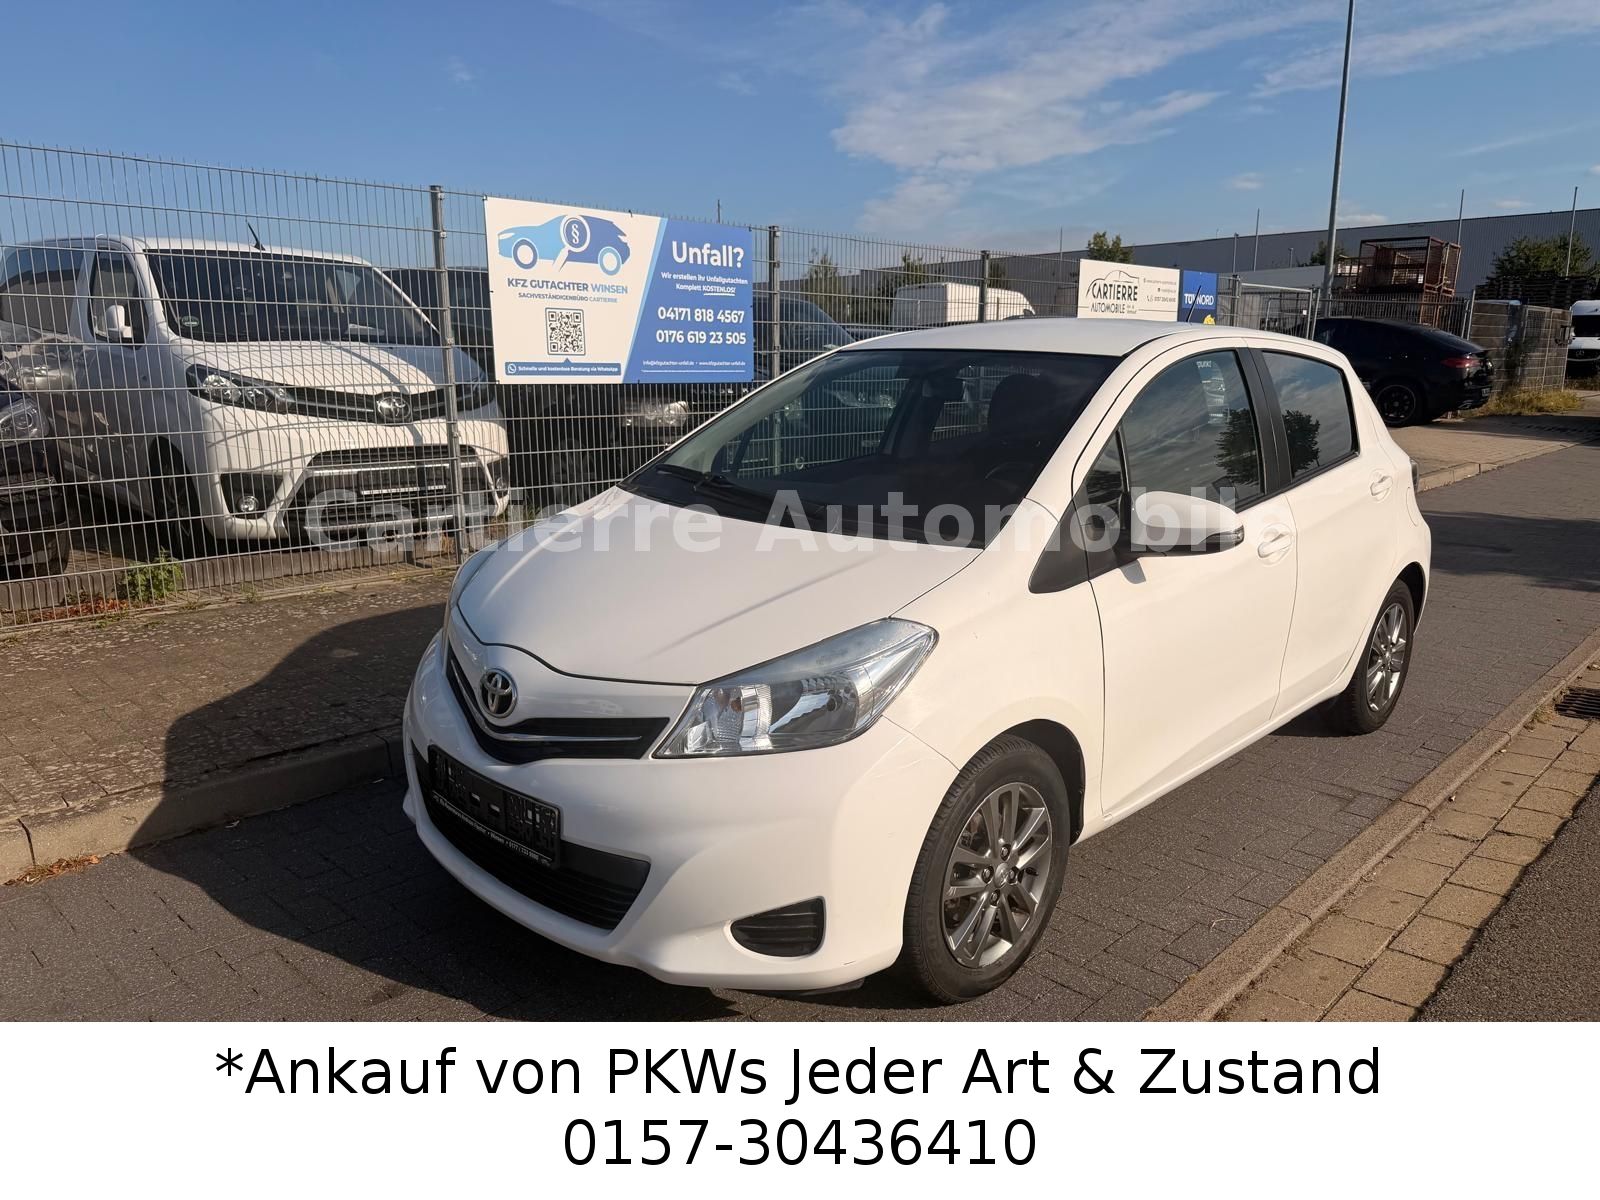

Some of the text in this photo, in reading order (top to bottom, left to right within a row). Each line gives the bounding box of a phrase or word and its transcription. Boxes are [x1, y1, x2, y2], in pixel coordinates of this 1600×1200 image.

[672, 241, 744, 268] Unfall?
[507, 278, 628, 294] KFZ GUTACHTER WINSEN
[1091, 282, 1138, 302] CARTIERRE
[658, 306, 744, 324] 04171 818 4567
[1090, 302, 1125, 314] AUTOMOBILE
[656, 330, 746, 345] 0176 619 23 505
